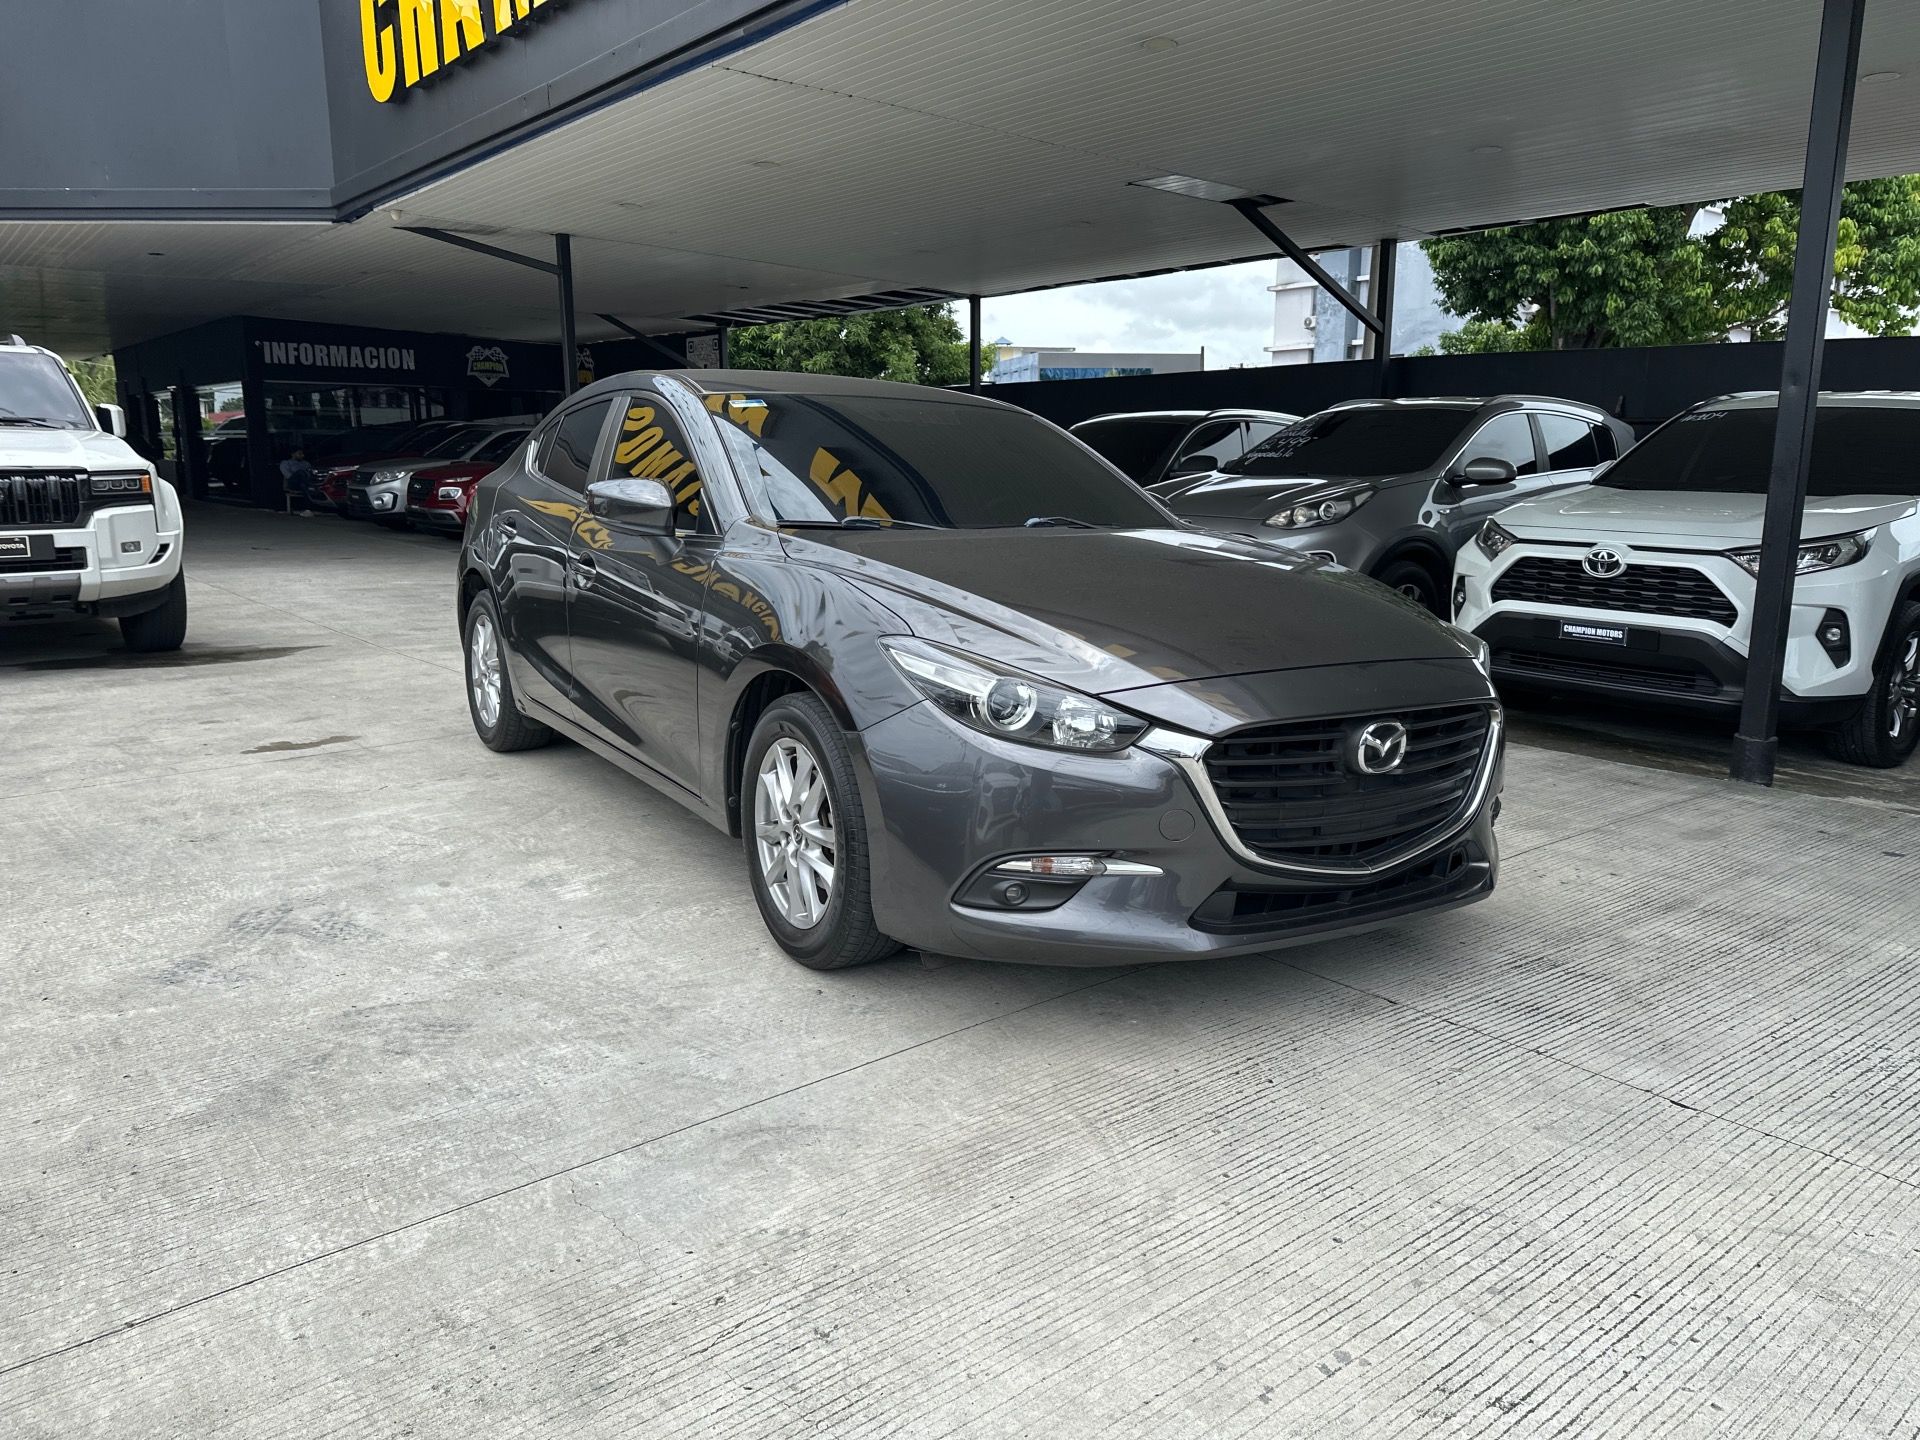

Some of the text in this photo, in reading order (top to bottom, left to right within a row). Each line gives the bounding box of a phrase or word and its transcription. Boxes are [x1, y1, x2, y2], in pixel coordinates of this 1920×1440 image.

[262, 341, 416, 370] INFORMACION
[1563, 624, 1596, 635] CHAMPION
[1596, 628, 1623, 639] MOTORS
